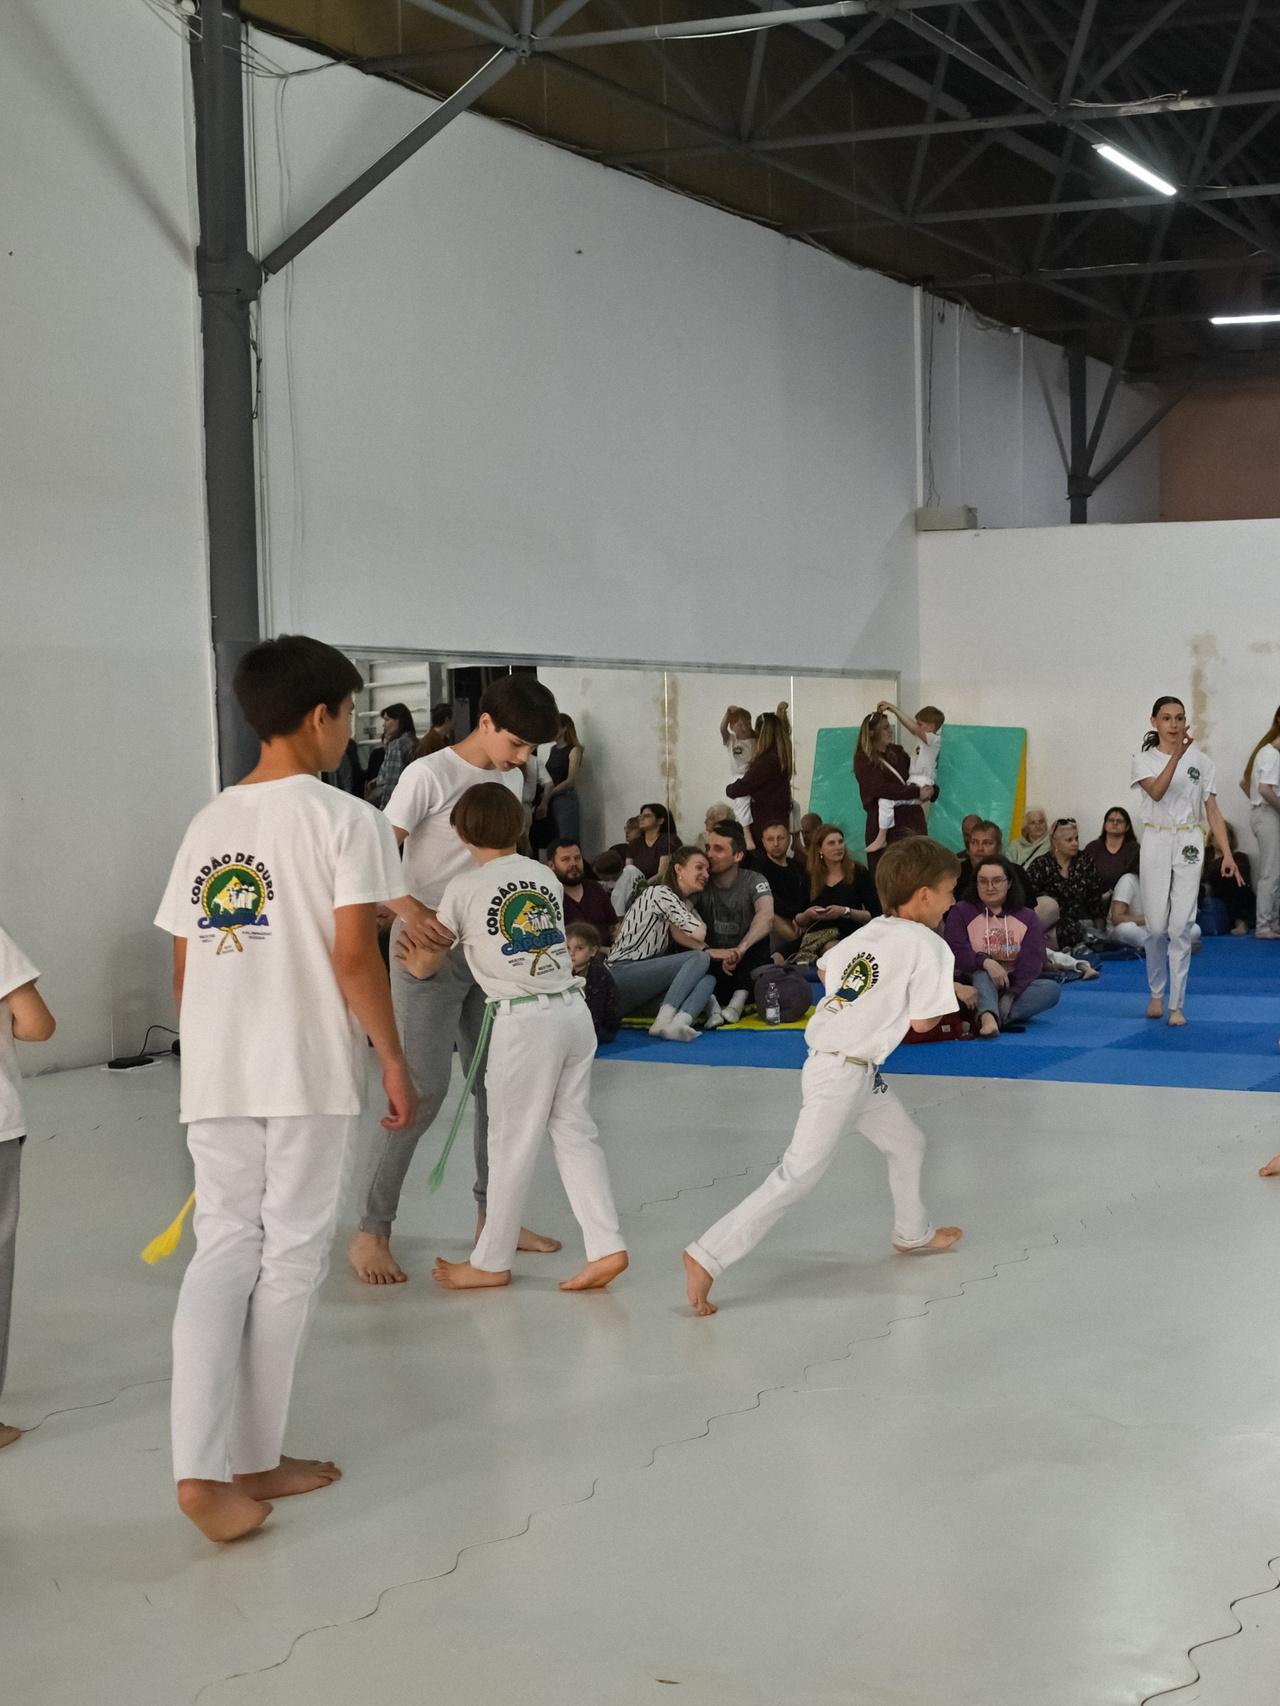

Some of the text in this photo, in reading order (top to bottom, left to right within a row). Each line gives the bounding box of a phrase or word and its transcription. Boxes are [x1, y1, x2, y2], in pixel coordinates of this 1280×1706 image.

[191, 852, 274, 905] CORDÃO DE OURO
[486, 881, 562, 936] CORDÃO DE OURO
